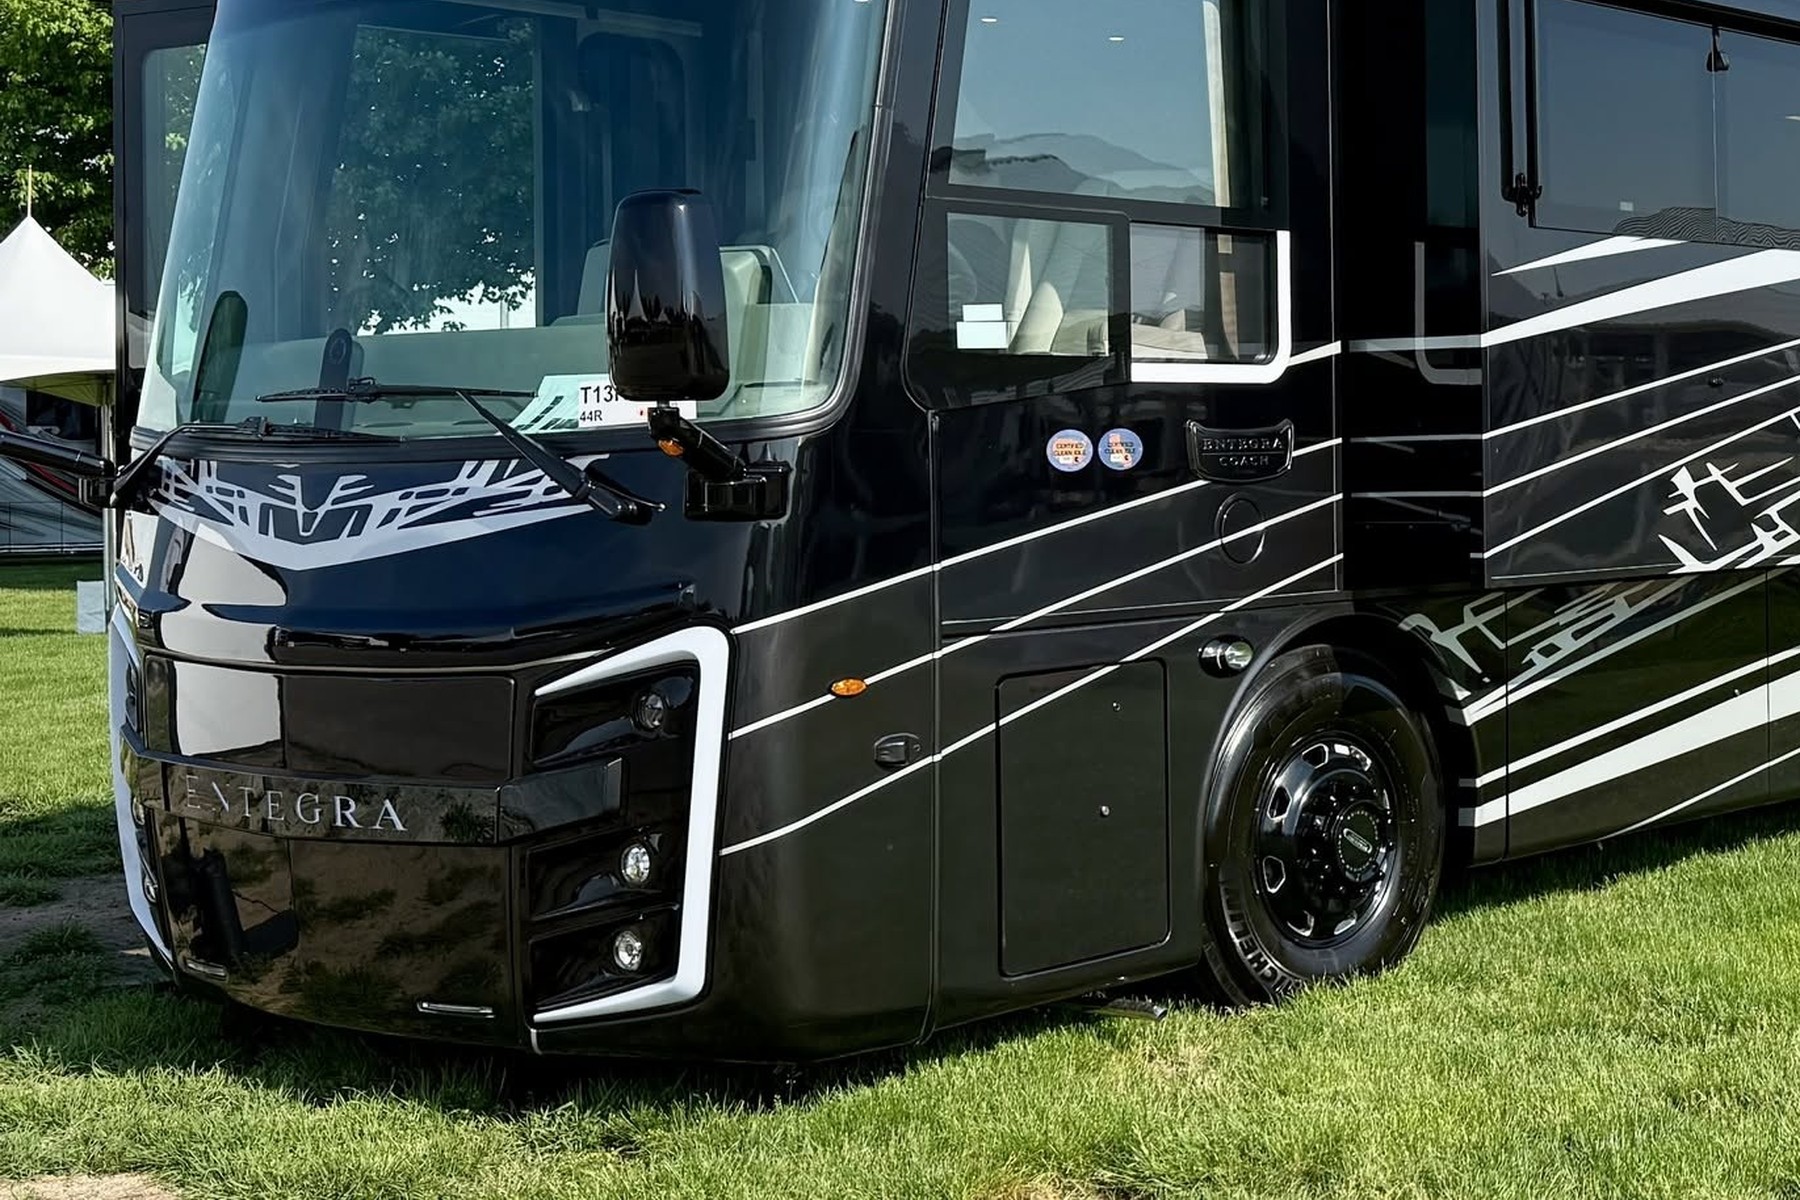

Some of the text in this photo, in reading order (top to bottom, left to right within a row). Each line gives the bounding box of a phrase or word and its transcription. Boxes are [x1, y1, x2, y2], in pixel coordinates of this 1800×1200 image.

[579, 410, 603, 422] 44R
[1202, 437, 1283, 450] ENTEGRA
[1219, 455, 1269, 467] COACH
[185, 775, 408, 832] ENTEGRA
